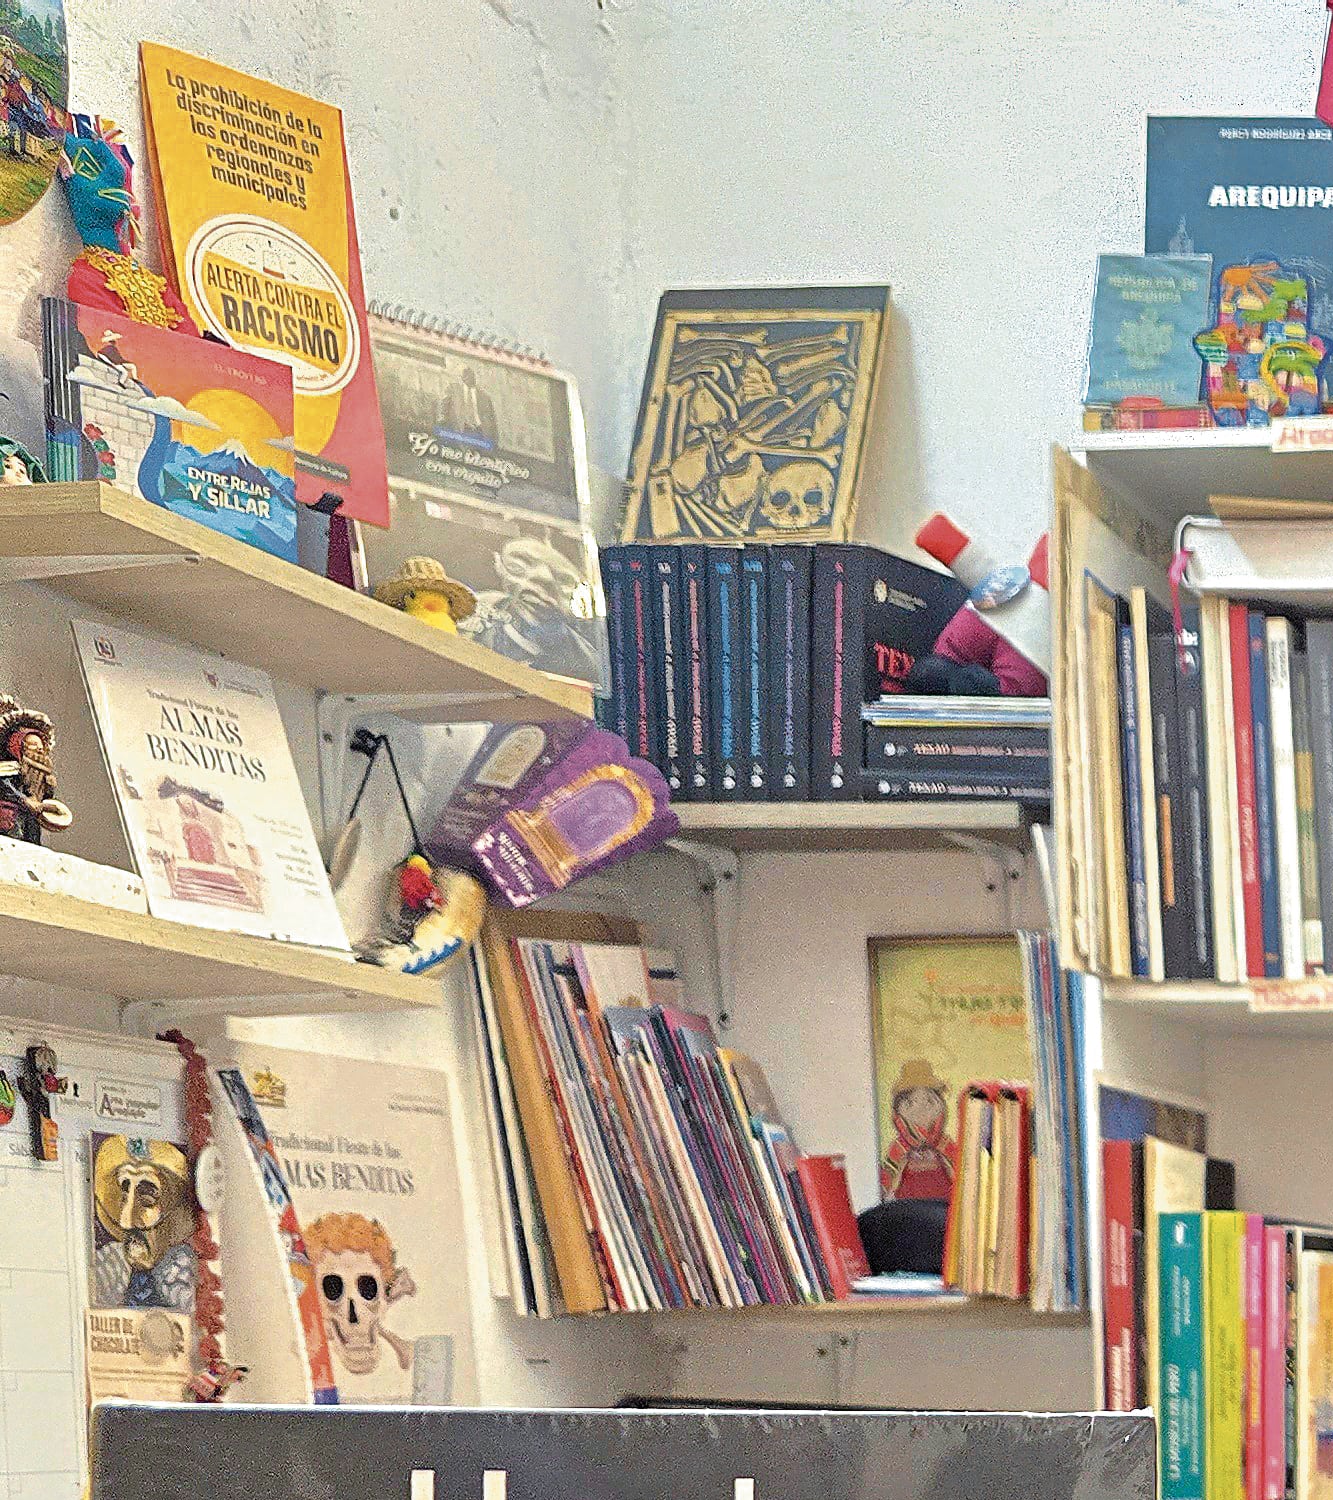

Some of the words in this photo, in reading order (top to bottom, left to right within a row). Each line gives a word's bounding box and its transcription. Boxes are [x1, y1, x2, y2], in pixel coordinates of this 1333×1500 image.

[166, 68, 187, 91] La
[191, 79, 281, 124] prohibición
[286, 110, 304, 133] de
[307, 118, 323, 140] la
[176, 93, 297, 149] discriminación
[301, 140, 320, 157] en
[190, 115, 216, 140] las
[221, 129, 313, 174] ordenanzas
[206, 143, 292, 186] regionales
[295, 174, 306, 195] y
[211, 164, 307, 210] municipales
[207, 262, 262, 302] ALERTA
[264, 280, 323, 323] CONTRA
[326, 301, 343, 329] EL
[221, 293, 340, 365] RACISMO
[187, 467, 231, 487] ENTRE
[230, 475, 270, 499] REJAS
[188, 482, 202, 501] Y
[208, 487, 270, 519] SILLAR
[160, 705, 243, 747] ALMAS
[145, 733, 266, 783] BENDITAS
[284, 1158, 326, 1190] MAS
